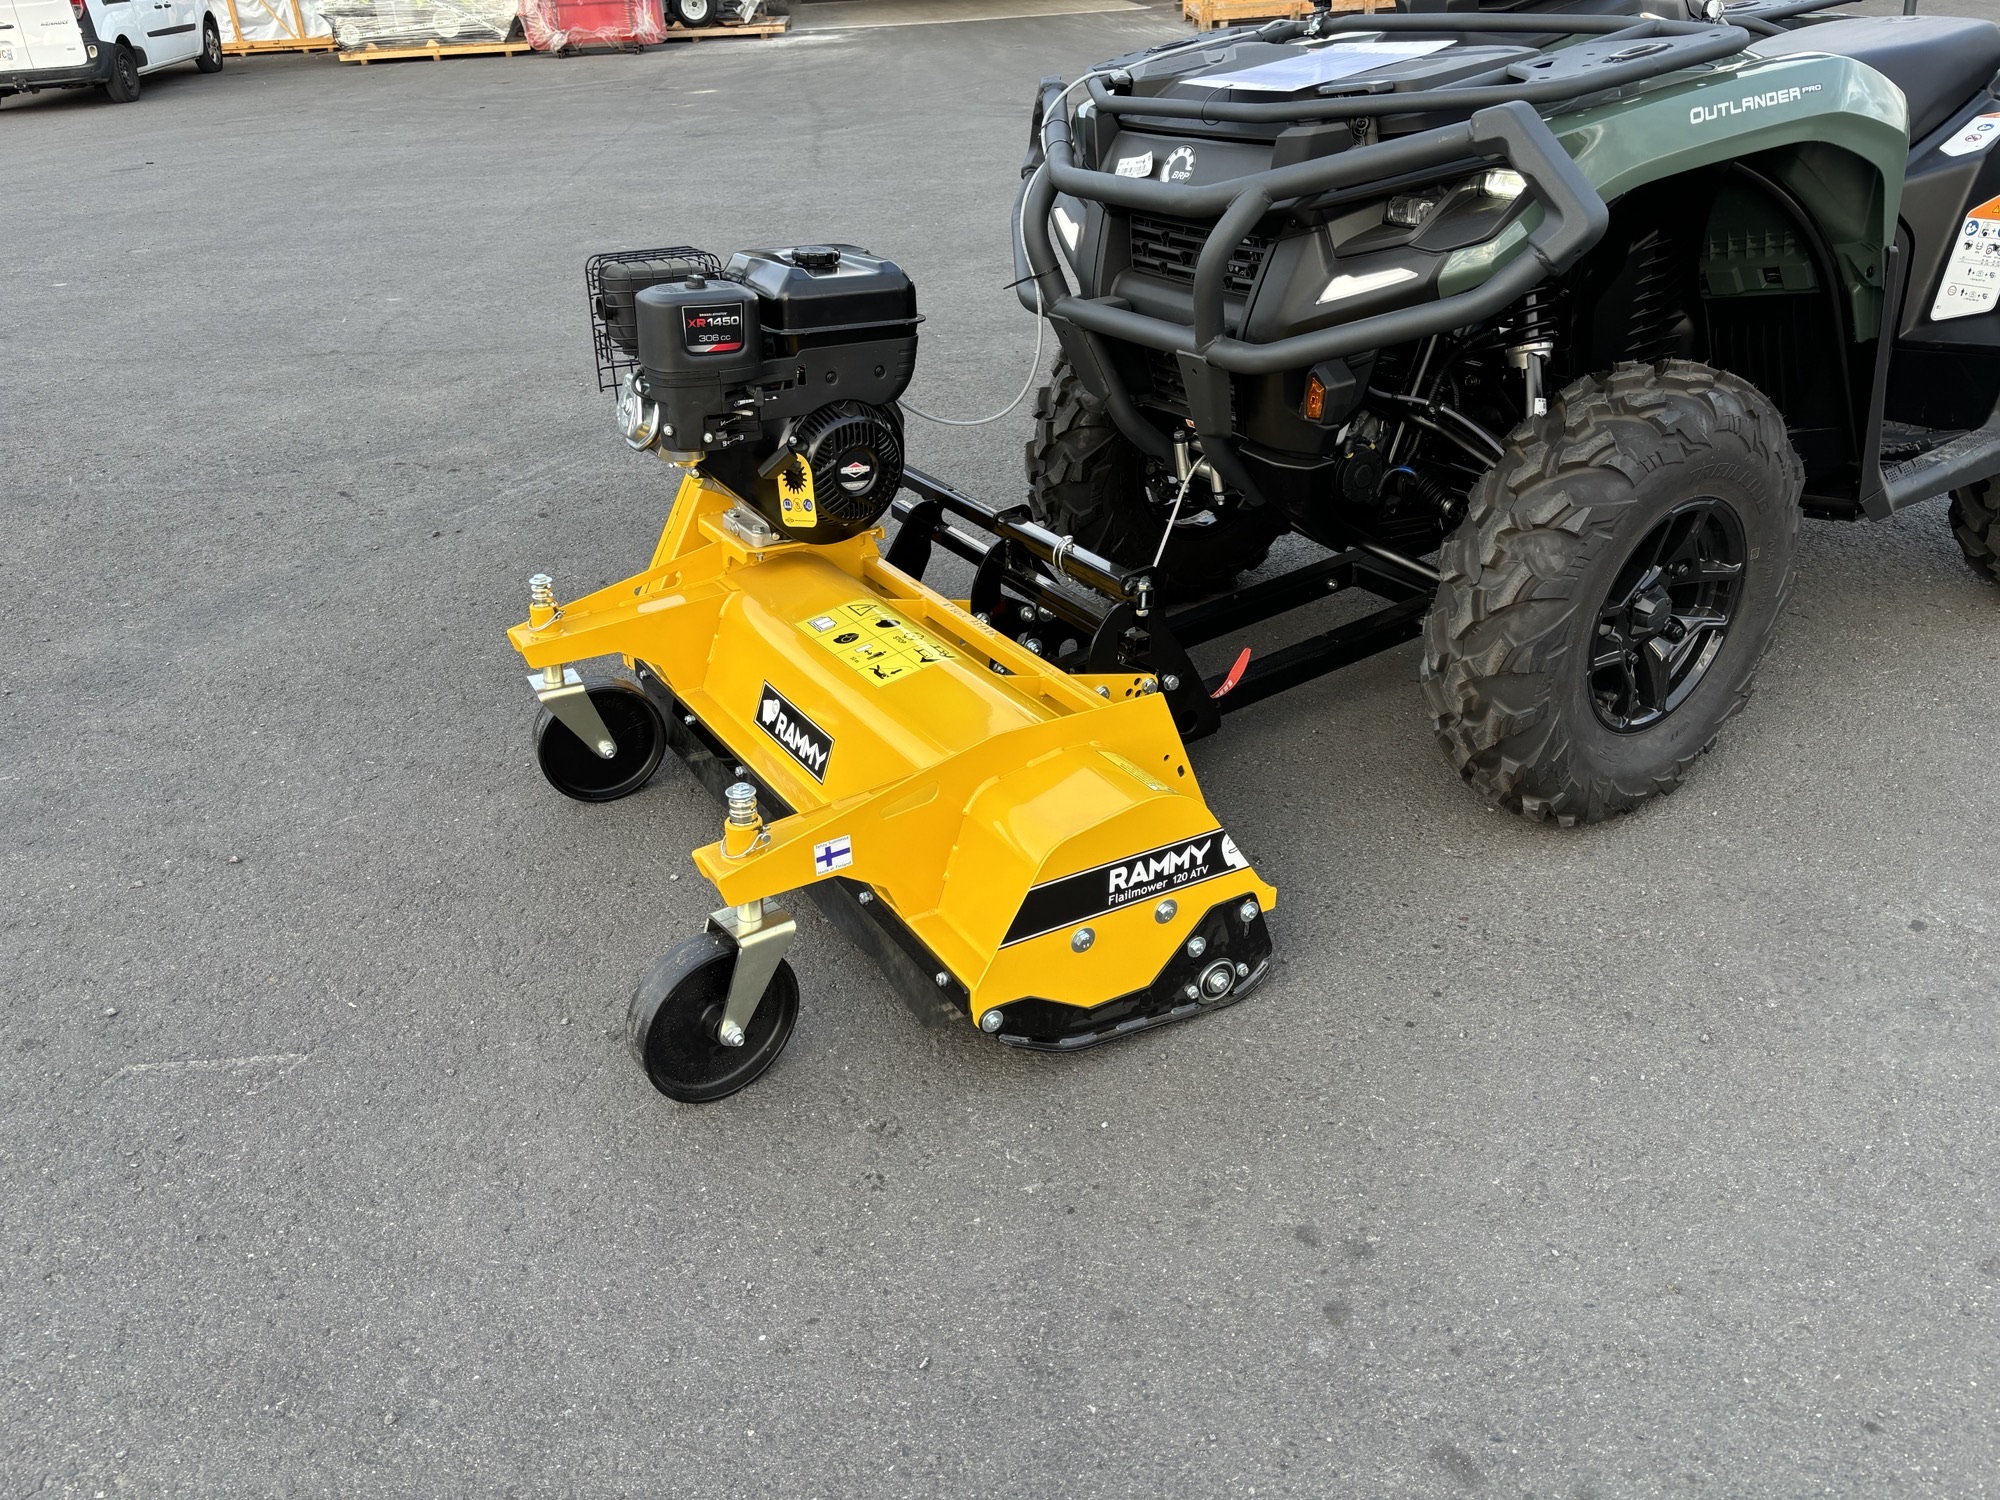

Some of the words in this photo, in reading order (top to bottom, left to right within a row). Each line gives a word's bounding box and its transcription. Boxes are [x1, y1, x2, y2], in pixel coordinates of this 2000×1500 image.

[1690, 87, 1801, 125] OUTLANDER
[1802, 84, 1822, 94] PRO
[1171, 171, 1191, 181] BRP
[699, 334, 720, 343] 306
[774, 711, 828, 771] RAMMY
[1108, 839, 1212, 894] RAMMY
[1108, 879, 1168, 906] Flailmower
[1172, 871, 1189, 885] 120
[1189, 864, 1210, 880] ATV
